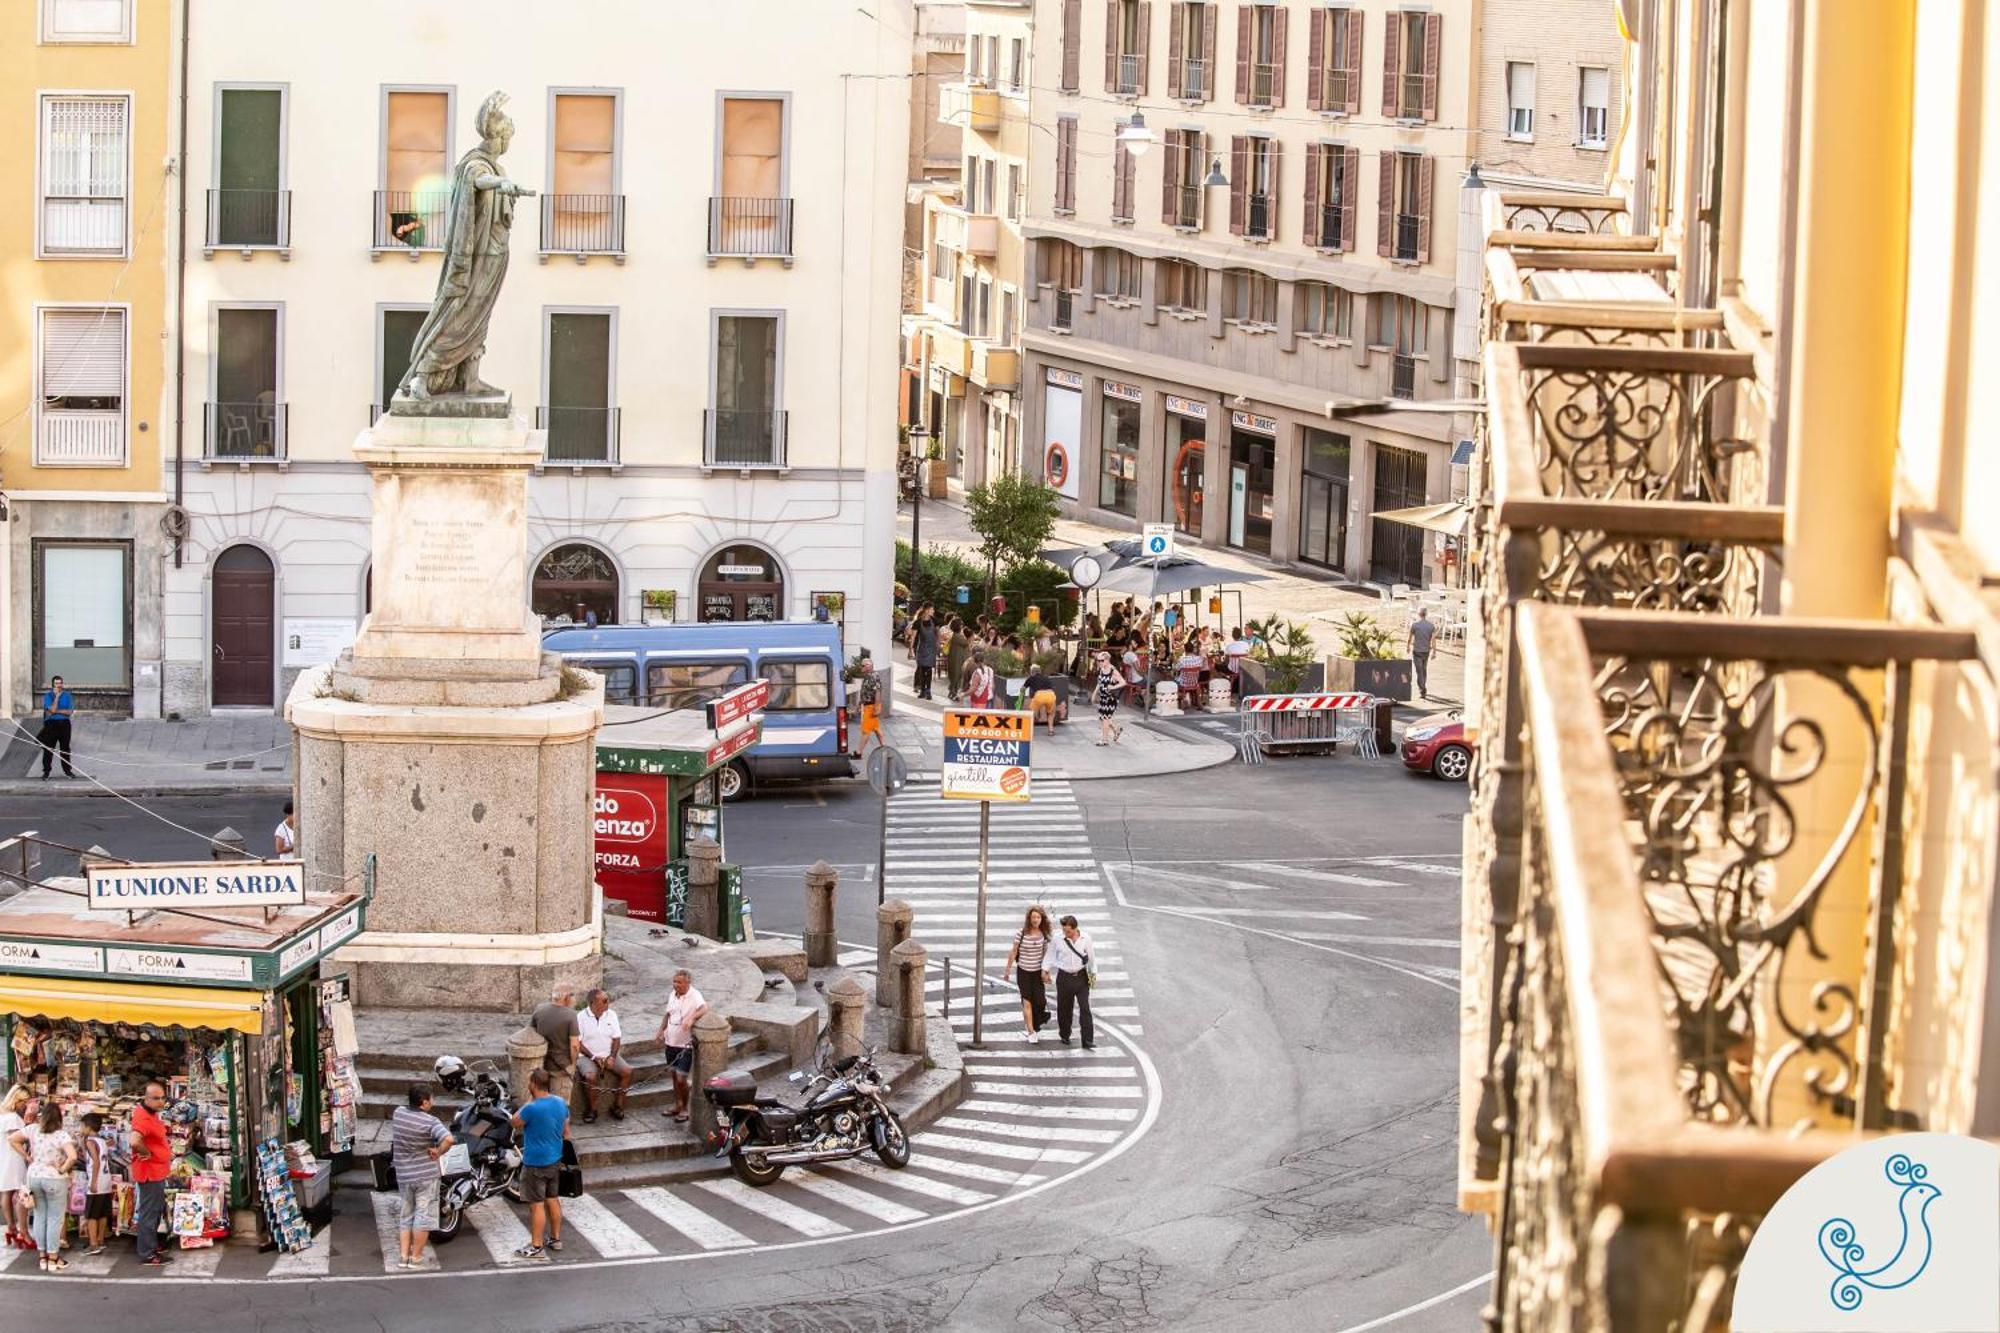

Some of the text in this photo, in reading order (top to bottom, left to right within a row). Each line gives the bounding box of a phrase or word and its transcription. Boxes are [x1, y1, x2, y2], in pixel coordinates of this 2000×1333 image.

[1123, 386, 1140, 398] DIREC
[1254, 417, 1277, 429] DIREC
[954, 714, 1023, 730] TAXI
[958, 728, 979, 736] 070
[956, 738, 1020, 756] VEGAN
[956, 754, 1020, 765] RESTAURANT
[594, 793, 619, 814] do
[595, 818, 645, 836] enza
[595, 852, 641, 867] FORZA
[96, 875, 298, 897] L'UNIONE SARDA
[1, 945, 40, 959] ORMA
